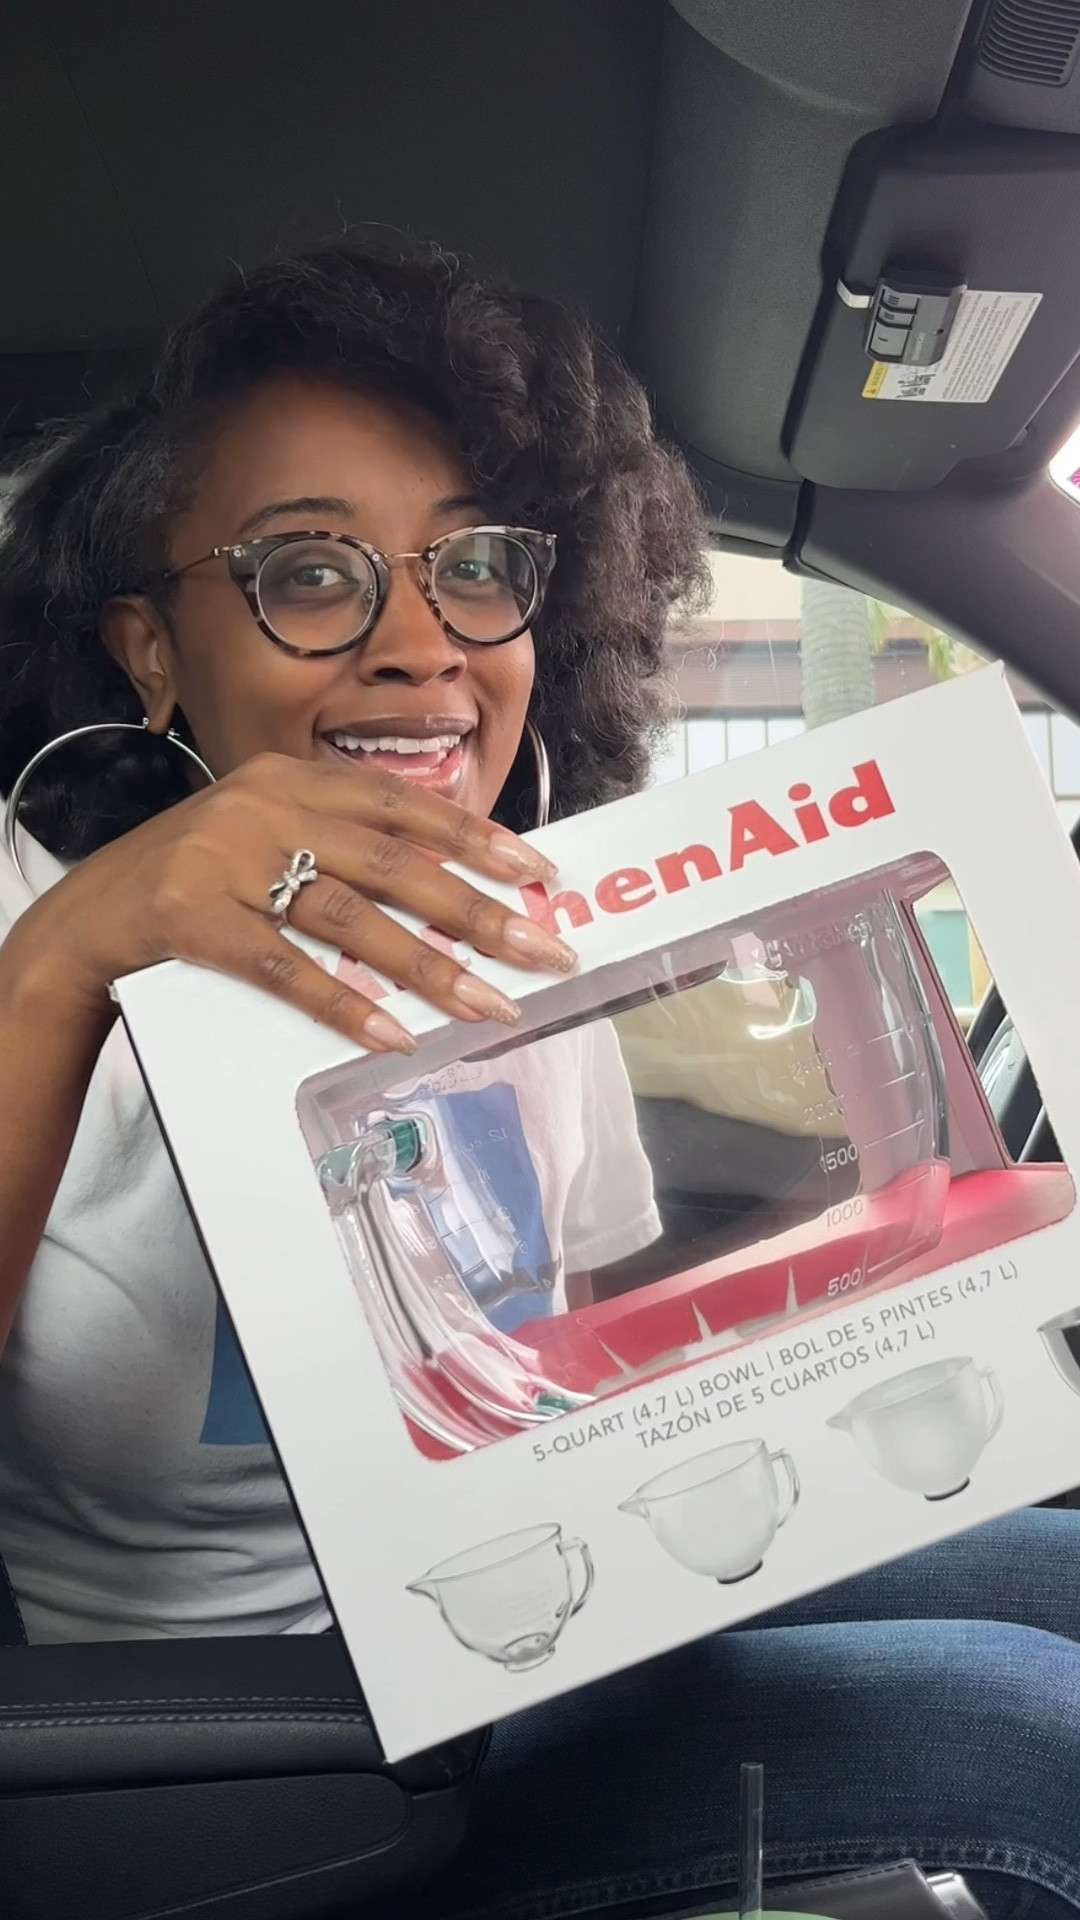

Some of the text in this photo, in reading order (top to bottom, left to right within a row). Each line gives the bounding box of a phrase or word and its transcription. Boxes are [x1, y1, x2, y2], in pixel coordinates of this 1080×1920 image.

[826, 1199, 864, 1229] 1000
[827, 1267, 862, 1297] 500
[532, 1411, 625, 1462] 5-QUART
[632, 1395, 667, 1426] (4.7
[675, 1386, 694, 1407] L)
[699, 1361, 764, 1397] BOWL
[779, 1338, 823, 1366] BOL
[827, 1322, 858, 1347] DE
[861, 1316, 875, 1334] 5
[880, 1285, 953, 1327] PINTES
[957, 1269, 991, 1299] (4,7
[998, 1260, 1019, 1280] L)
[635, 1320, 935, 1448] TAZÓN DE 5 CUARTOS (4,7 L)
